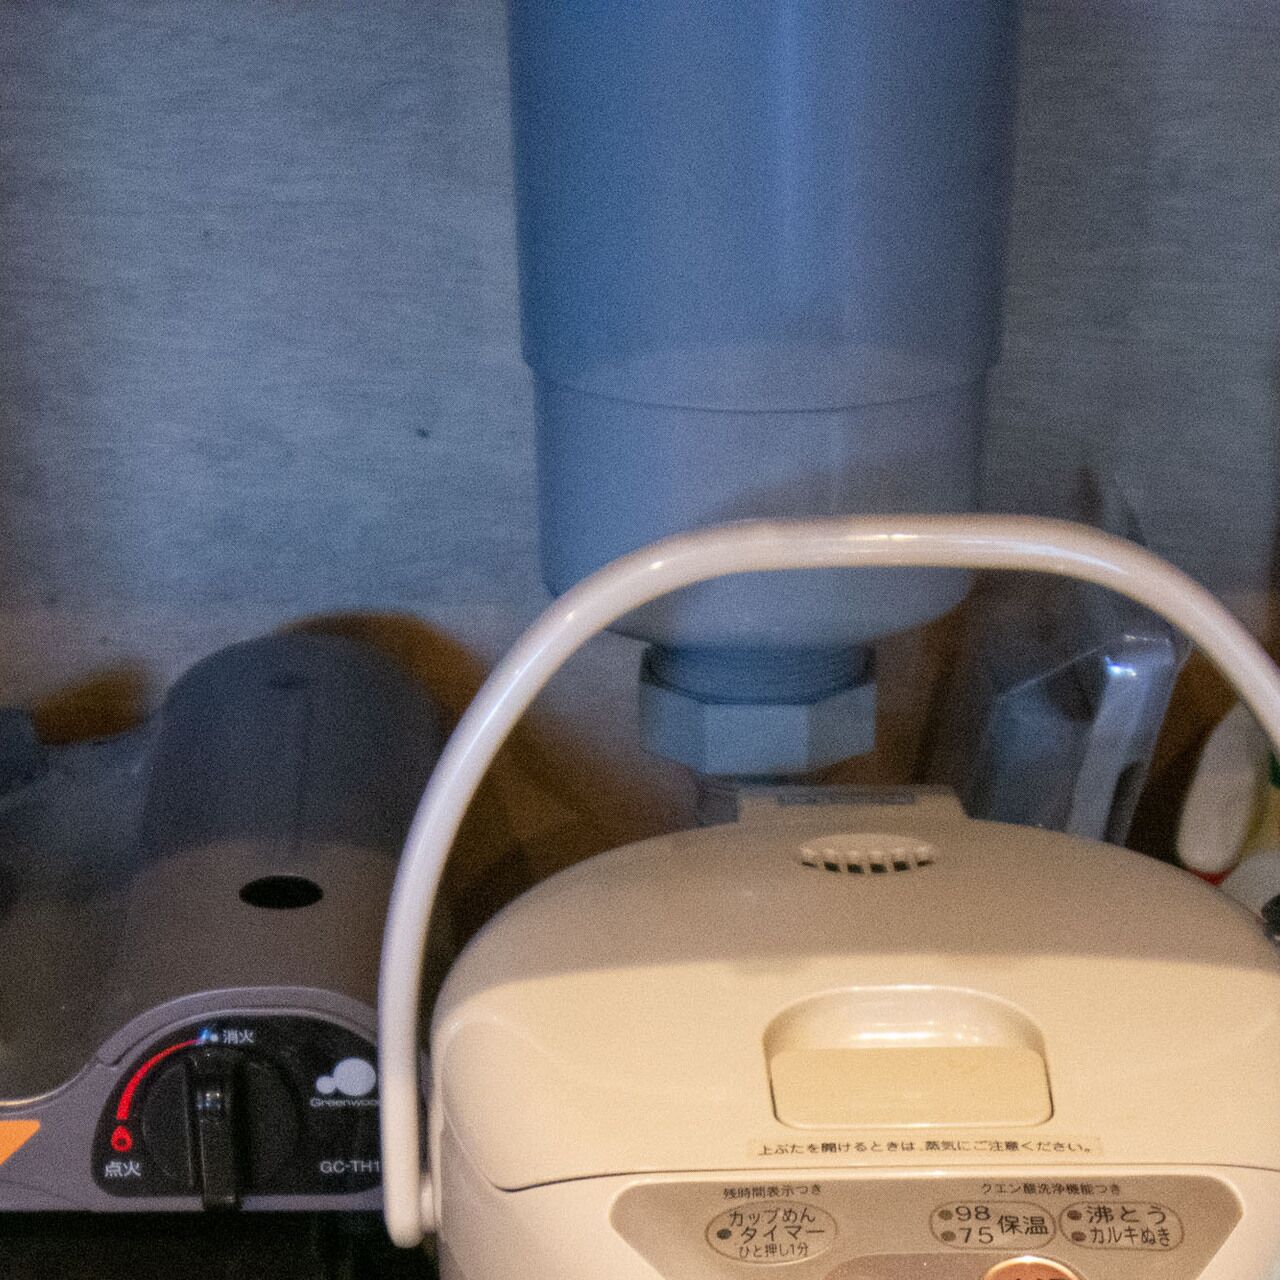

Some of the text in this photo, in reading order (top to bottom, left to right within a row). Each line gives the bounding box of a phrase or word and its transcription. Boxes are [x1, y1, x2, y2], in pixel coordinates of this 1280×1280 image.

[223, 1030, 255, 1044] 消火
[310, 1097, 378, 1108] Greenwoo
[104, 1160, 142, 1177] 点火
[723, 1184, 821, 1200] 残時間表示つき
[981, 1183, 1121, 1195] クエン酸洗浄機能つき
[729, 1207, 816, 1227] カップめん
[955, 1205, 991, 1221] 98
[1086, 1205, 1167, 1225] 沸とう
[997, 1214, 1049, 1236] 保温
[740, 1225, 825, 1244] タイマー
[958, 1227, 994, 1244] 75
[1090, 1226, 1171, 1247] カルキぬき
[739, 1242, 809, 1258] ひと押し1分
